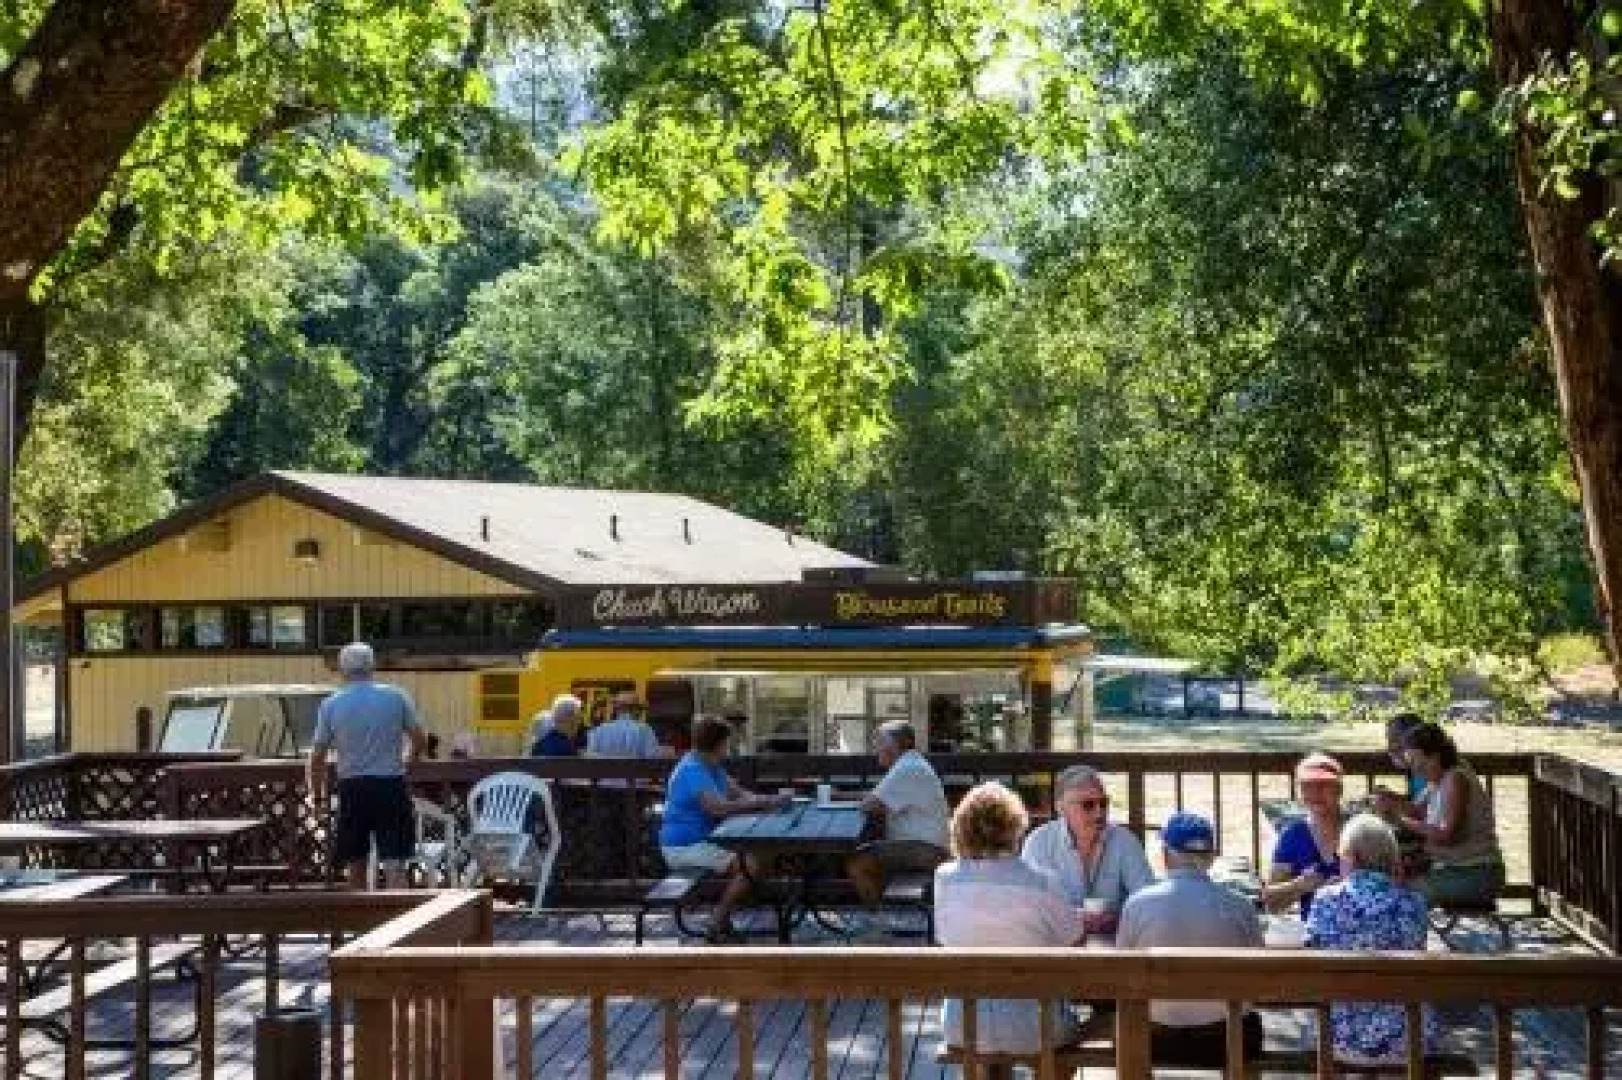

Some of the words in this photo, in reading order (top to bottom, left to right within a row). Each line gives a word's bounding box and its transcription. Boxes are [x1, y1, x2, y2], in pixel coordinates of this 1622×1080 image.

[592, 587, 665, 619] Chuck
[668, 587, 760, 617] Wagon
[836, 591, 938, 620] Thousand
[943, 591, 1006, 618] Trails
